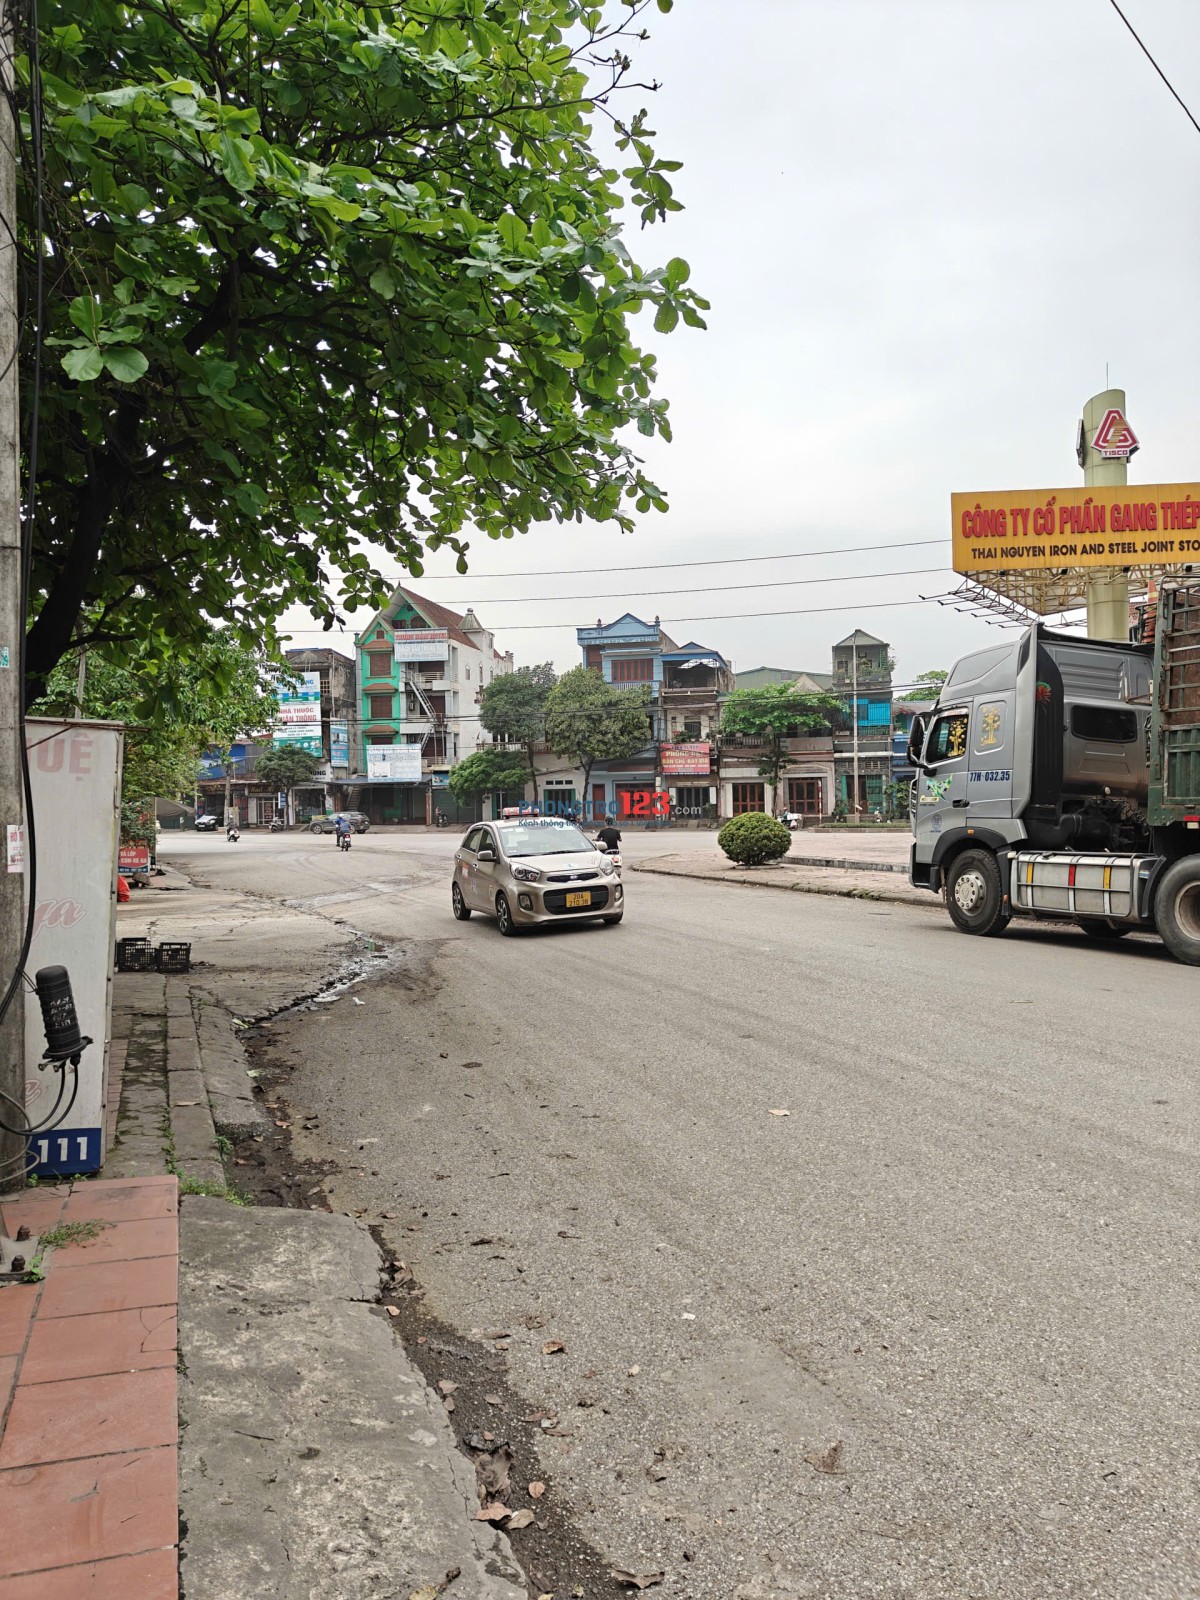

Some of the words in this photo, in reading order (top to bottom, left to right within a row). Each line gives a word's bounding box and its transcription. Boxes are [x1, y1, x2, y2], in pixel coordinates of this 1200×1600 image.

[962, 503, 1006, 538] CÔNG
[1010, 508, 1030, 536] TY
[1033, 496, 1056, 536] CỔ
[1059, 497, 1106, 534] PHẦN
[1110, 502, 1157, 532] GANG
[1161, 494, 1200, 530] THÉP
[972, 547, 997, 559] THAI
[1000, 545, 1046, 558] NGUYEN
[1049, 544, 1077, 557] IRON
[1080, 542, 1105, 555] AND
[1108, 541, 1138, 554] STEEL
[1141, 540, 1175, 553] JOINT
[37, 1136, 88, 1164] 111
